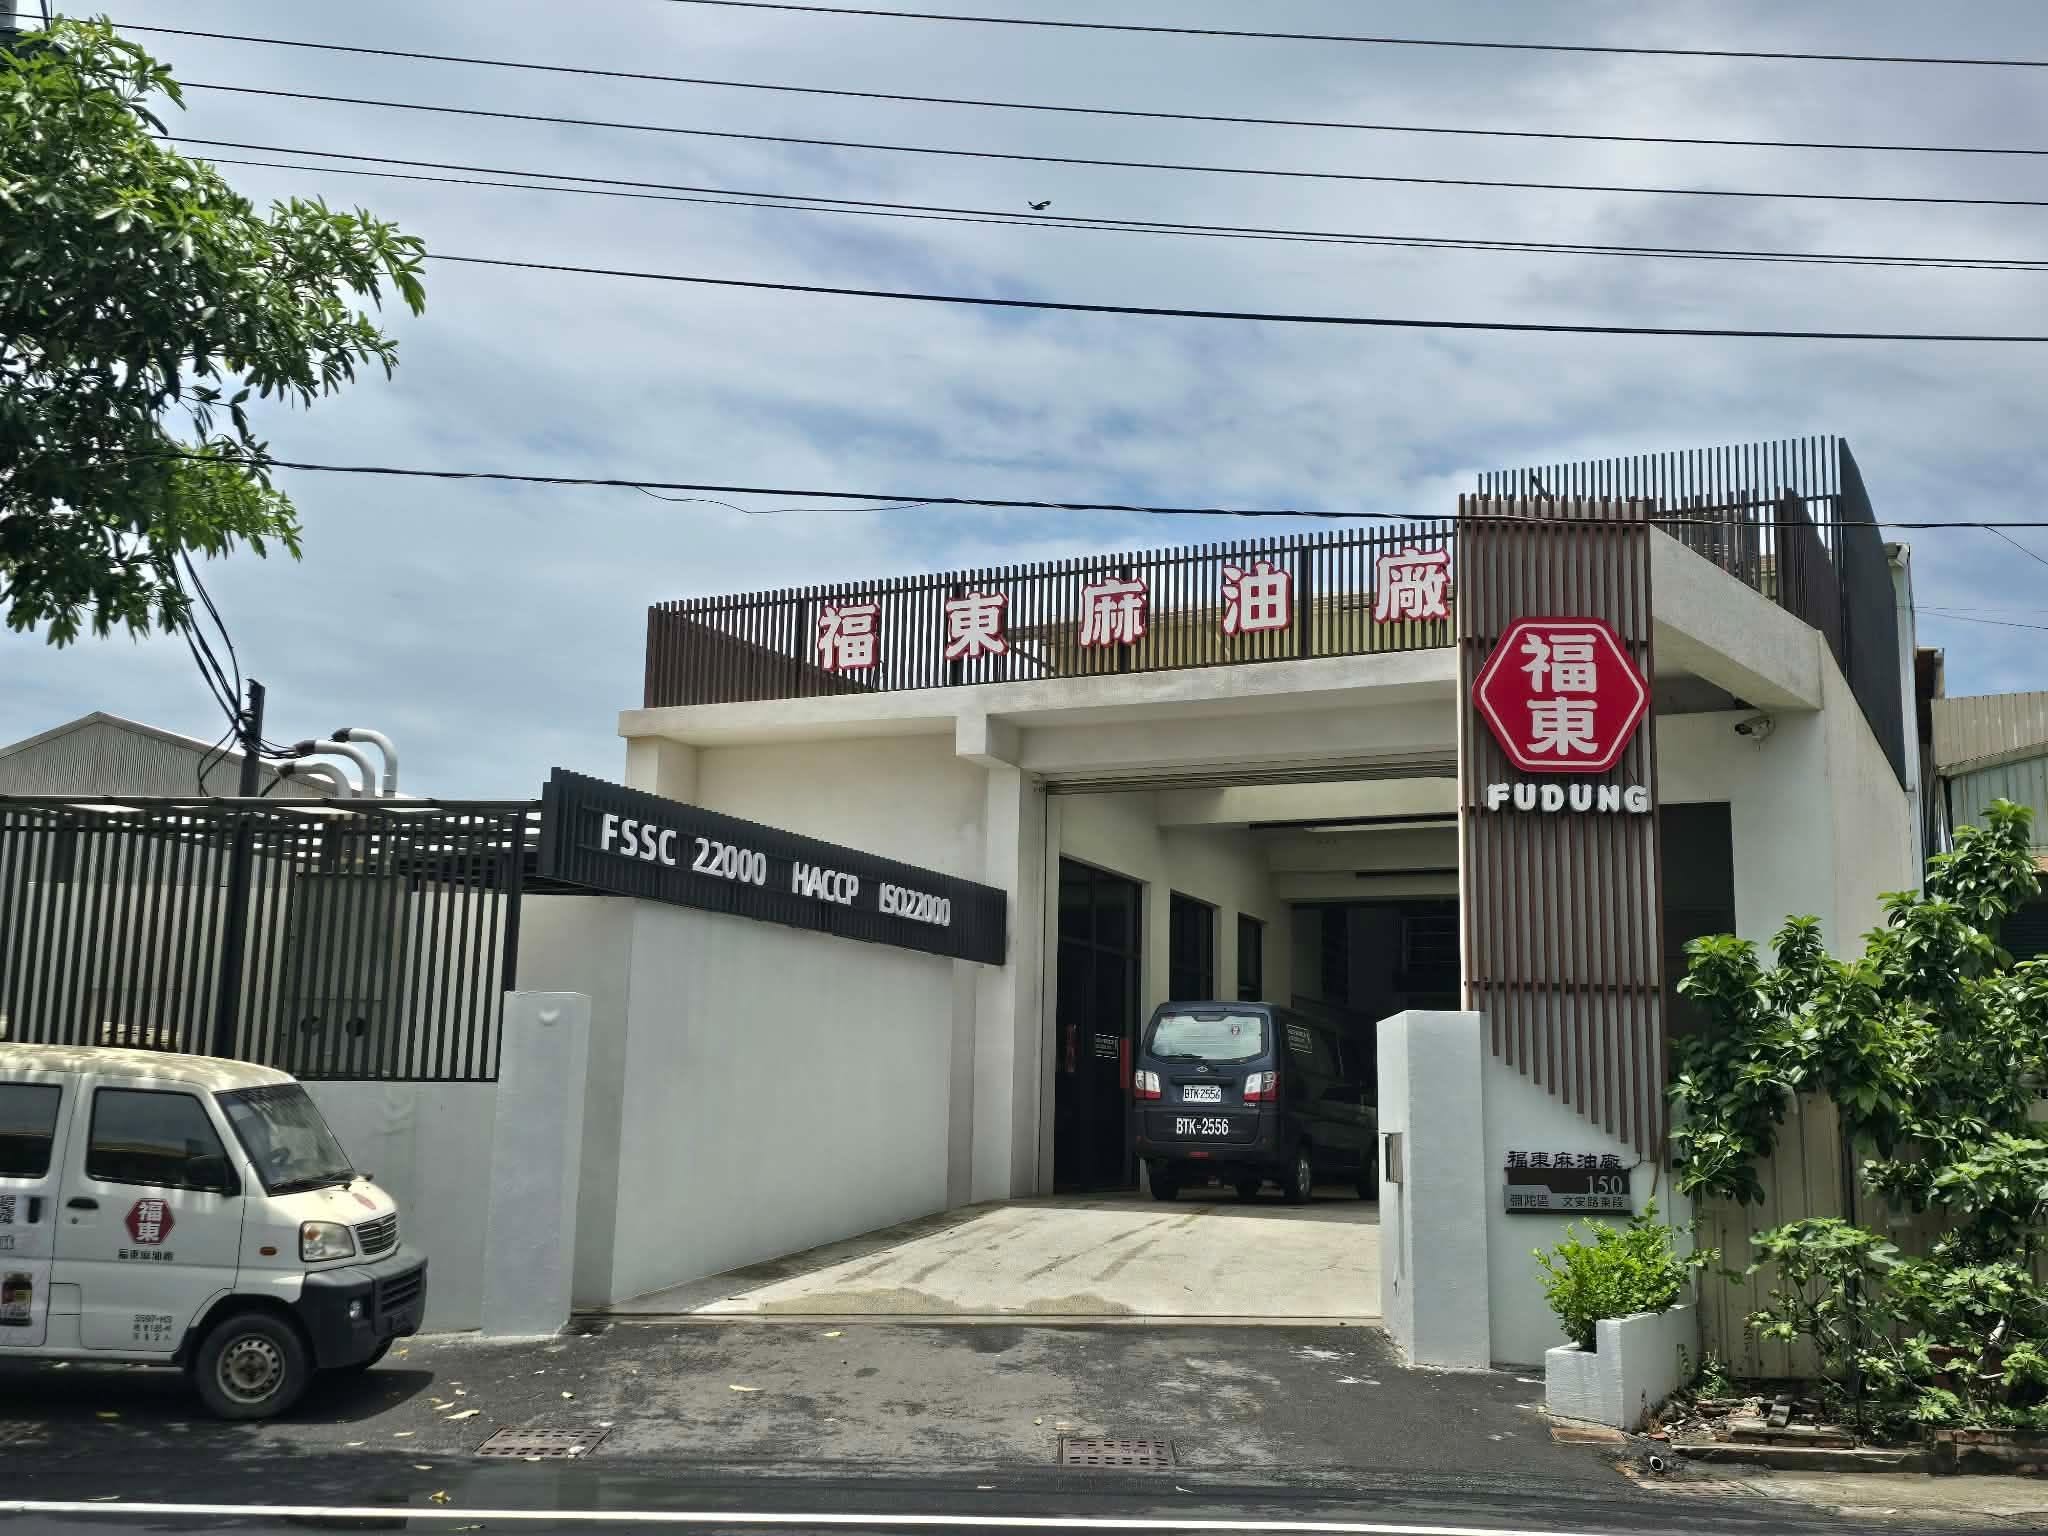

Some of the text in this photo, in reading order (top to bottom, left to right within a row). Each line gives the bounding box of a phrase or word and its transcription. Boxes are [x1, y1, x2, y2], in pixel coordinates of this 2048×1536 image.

[817, 548, 1451, 672] 福東麻油廠
[1520, 633, 1599, 756] 福東
[1487, 782, 1649, 813] FUDUNG
[600, 813, 951, 927] FSSC 22000 HACCP ISO22000
[1176, 1117, 1229, 1136] BTK-2556
[1507, 1151, 1622, 1169] 福東麻油廠
[1587, 1175, 1623, 1195] 150
[136, 1201, 163, 1243] 福東
